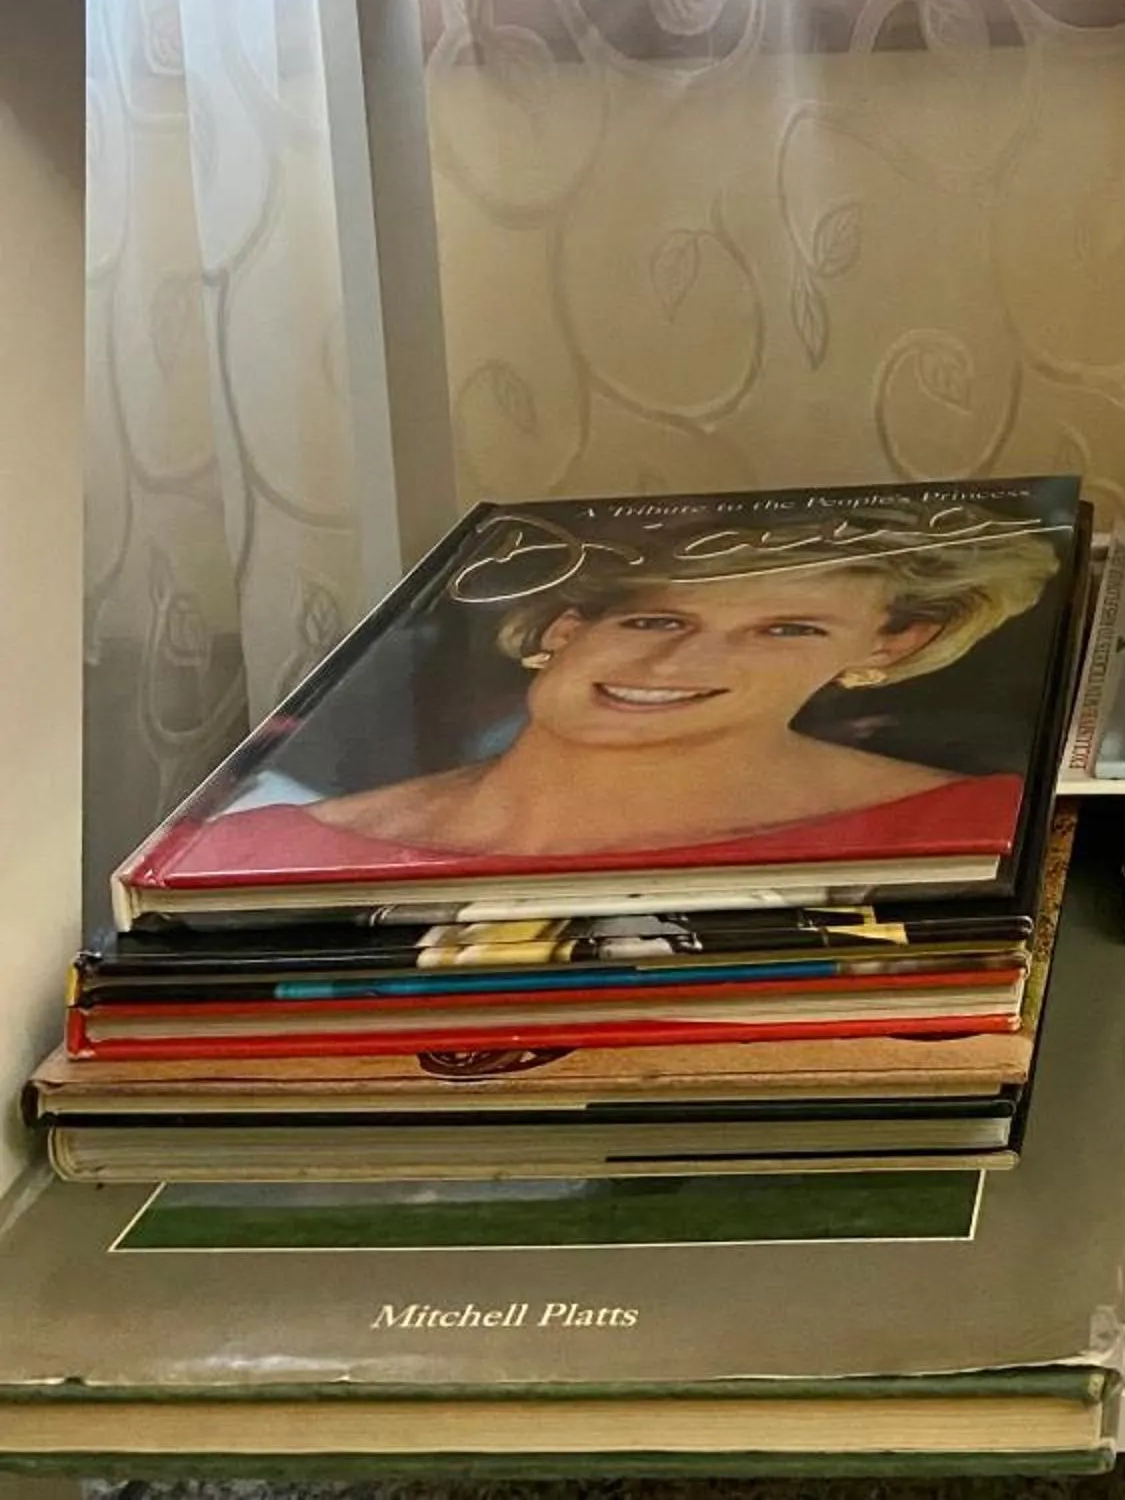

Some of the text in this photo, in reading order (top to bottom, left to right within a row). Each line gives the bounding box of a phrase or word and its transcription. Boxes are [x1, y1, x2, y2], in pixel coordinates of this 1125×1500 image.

[574, 506, 597, 519] A
[608, 502, 709, 519] Tribute
[716, 500, 745, 512] to
[752, 498, 796, 511] the
[922, 489, 1032, 503] Princess
[369, 1302, 639, 1330] Mitchell Platts
